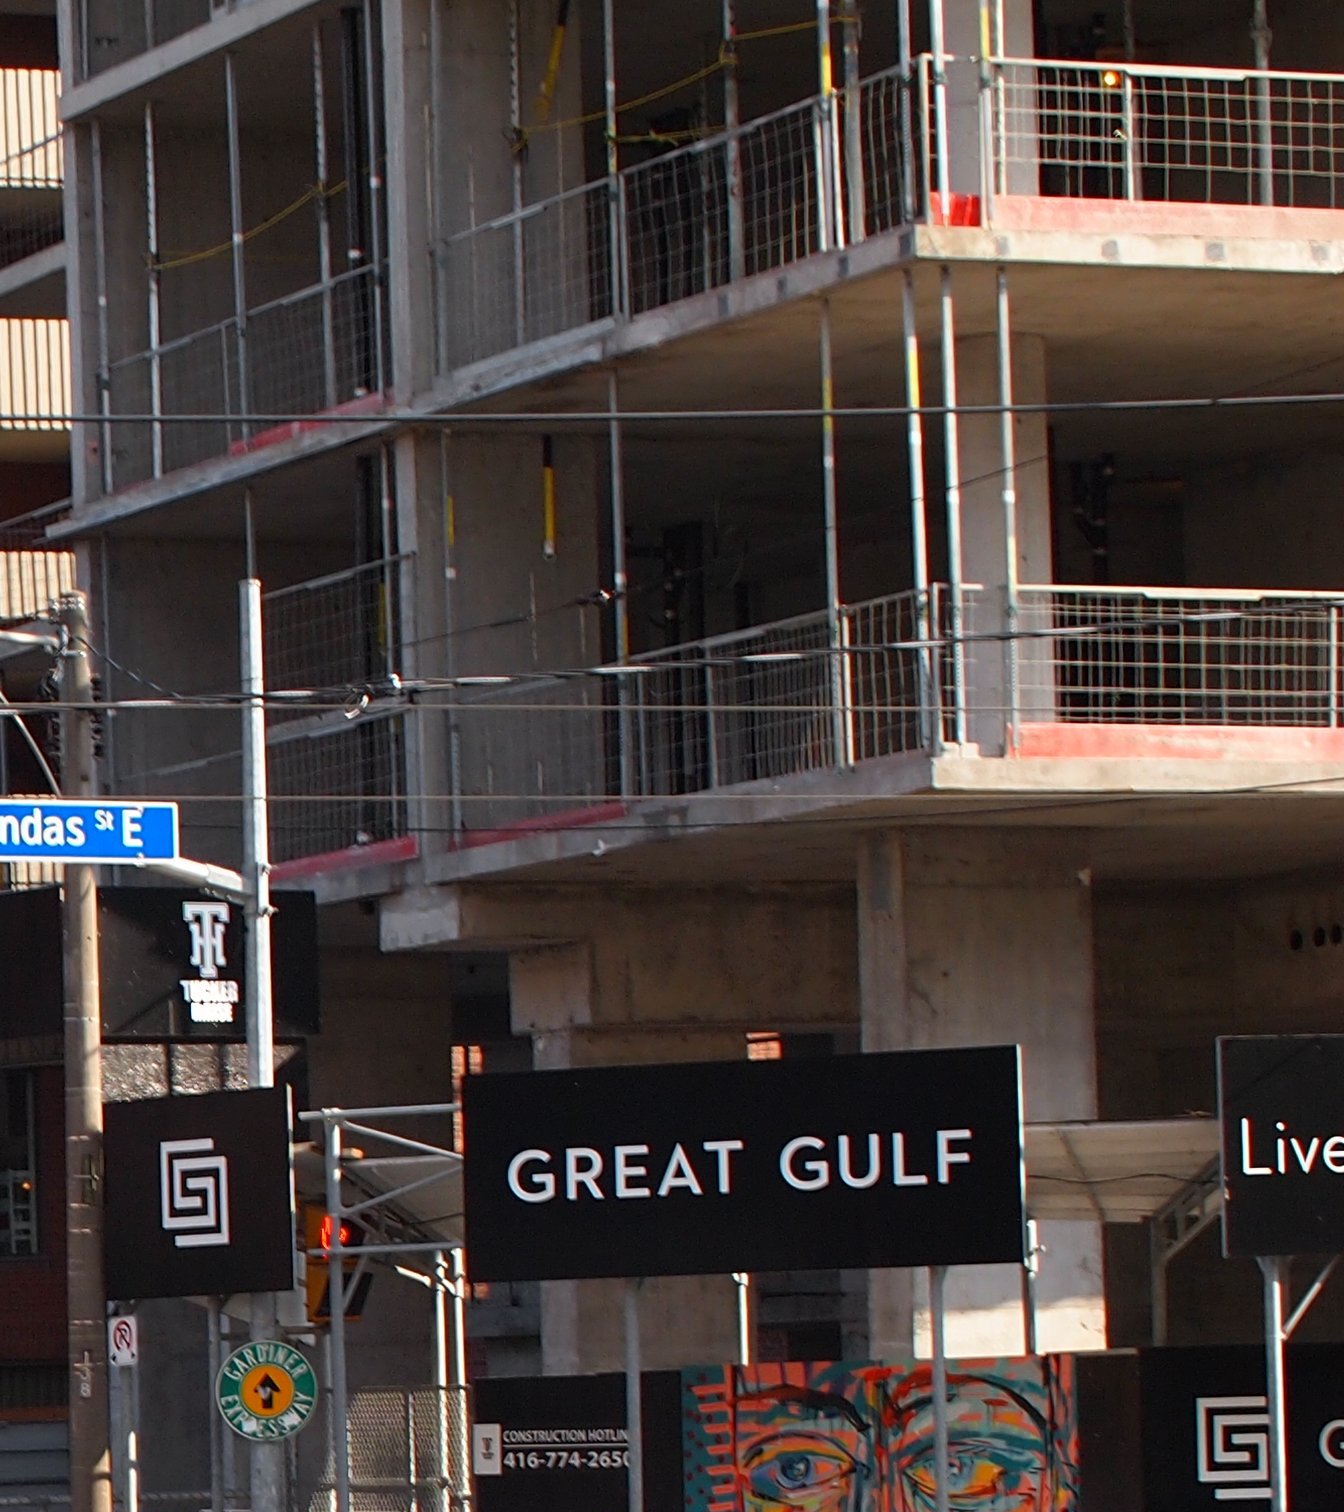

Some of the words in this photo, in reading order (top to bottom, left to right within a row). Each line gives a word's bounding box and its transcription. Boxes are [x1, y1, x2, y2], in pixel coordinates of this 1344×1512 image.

[94, 809, 114, 831] St
[122, 808, 144, 847] E
[507, 1139, 744, 1203] GREAT
[779, 1128, 972, 1192] GULF
[1241, 1117, 1344, 1175] Live
[222, 1343, 308, 1380] GARDINER
[220, 1391, 313, 1438] EXPESSWAY
[503, 1429, 586, 1443] CONSTRUCTION
[588, 1428, 629, 1442] HOTLIN
